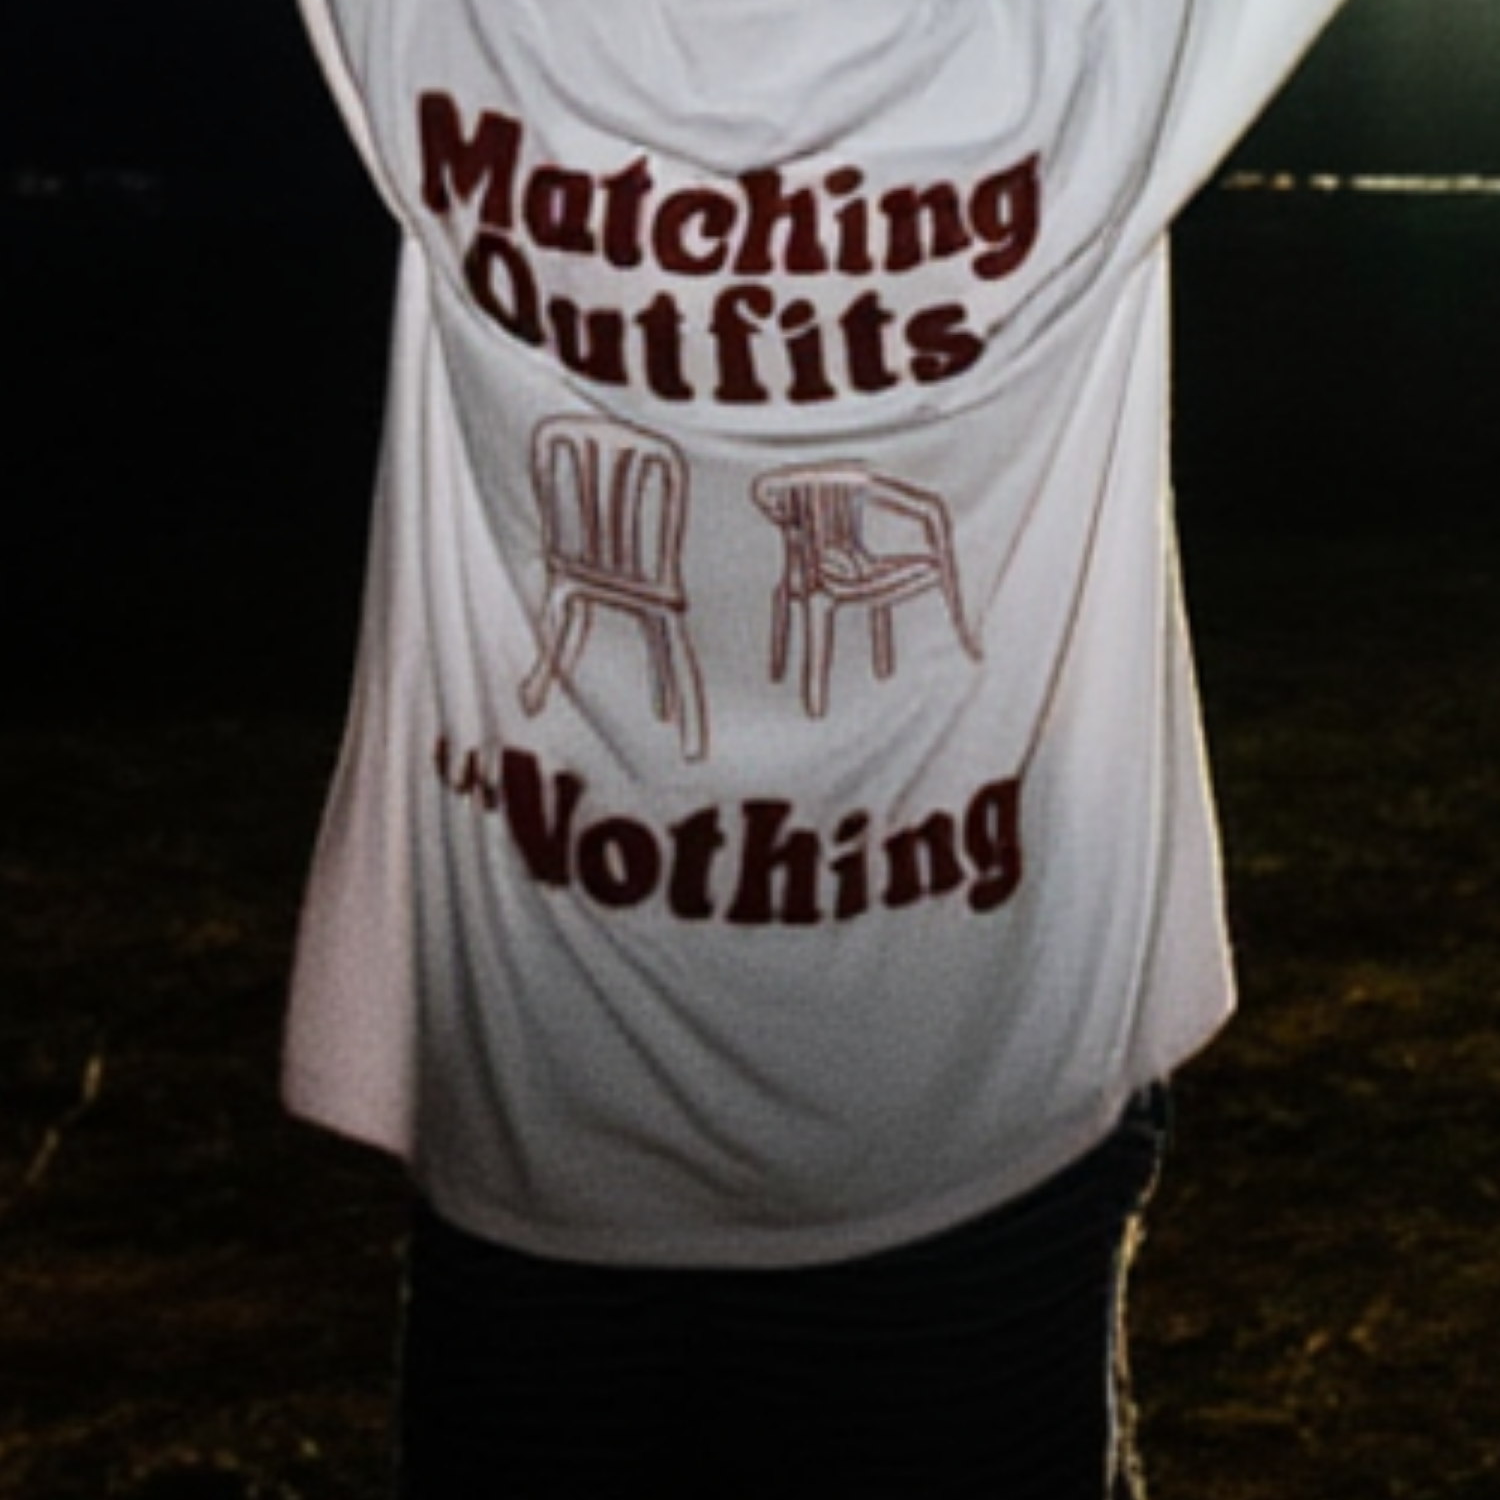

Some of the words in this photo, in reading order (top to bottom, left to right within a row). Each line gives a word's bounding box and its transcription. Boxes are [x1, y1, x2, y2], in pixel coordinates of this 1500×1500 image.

[416, 91, 1041, 280] Matching
[463, 232, 987, 405] Outfits
[500, 746, 1023, 926] Nothing
